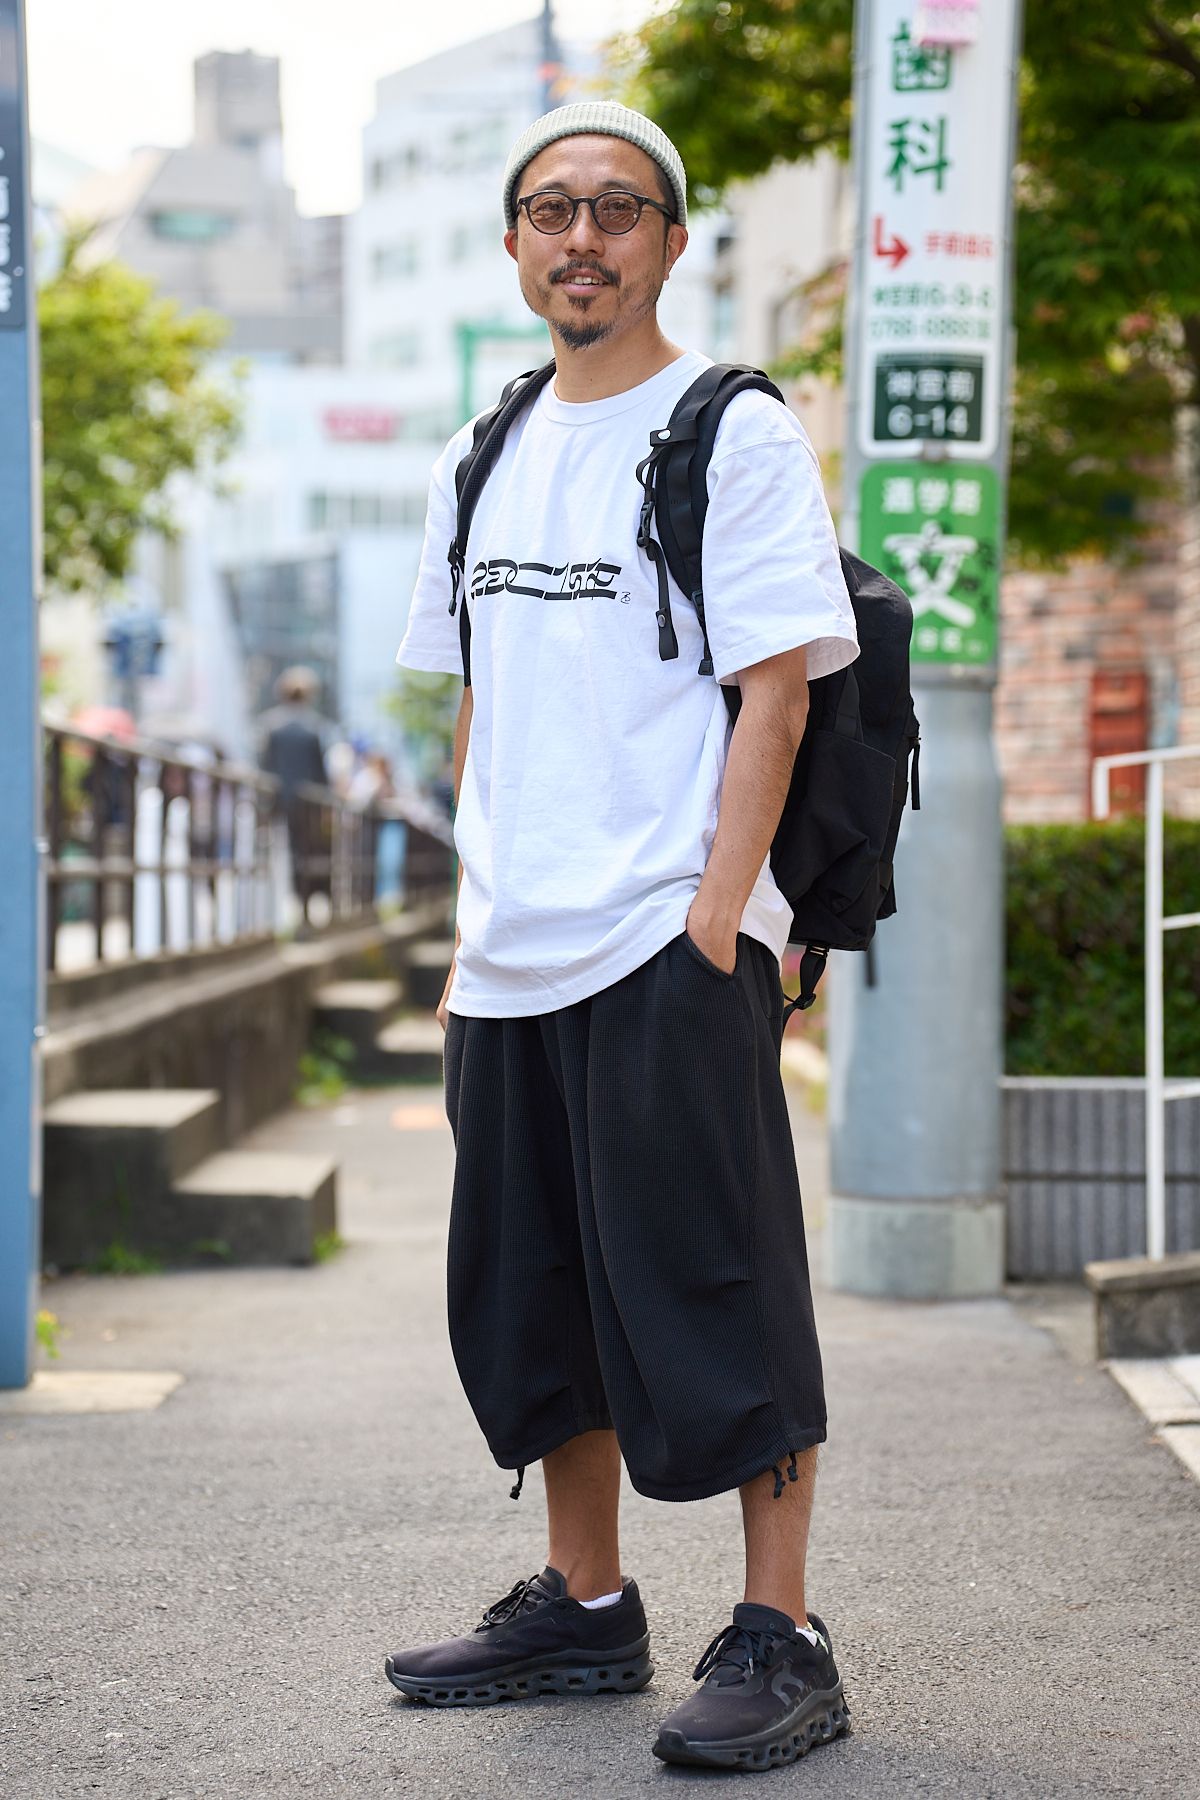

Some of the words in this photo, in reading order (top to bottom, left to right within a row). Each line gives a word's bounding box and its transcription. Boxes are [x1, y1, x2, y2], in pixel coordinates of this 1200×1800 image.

[886, 369, 975, 402] 神宮前
[887, 404, 969, 438] 6-14
[881, 476, 982, 516] 通学路
